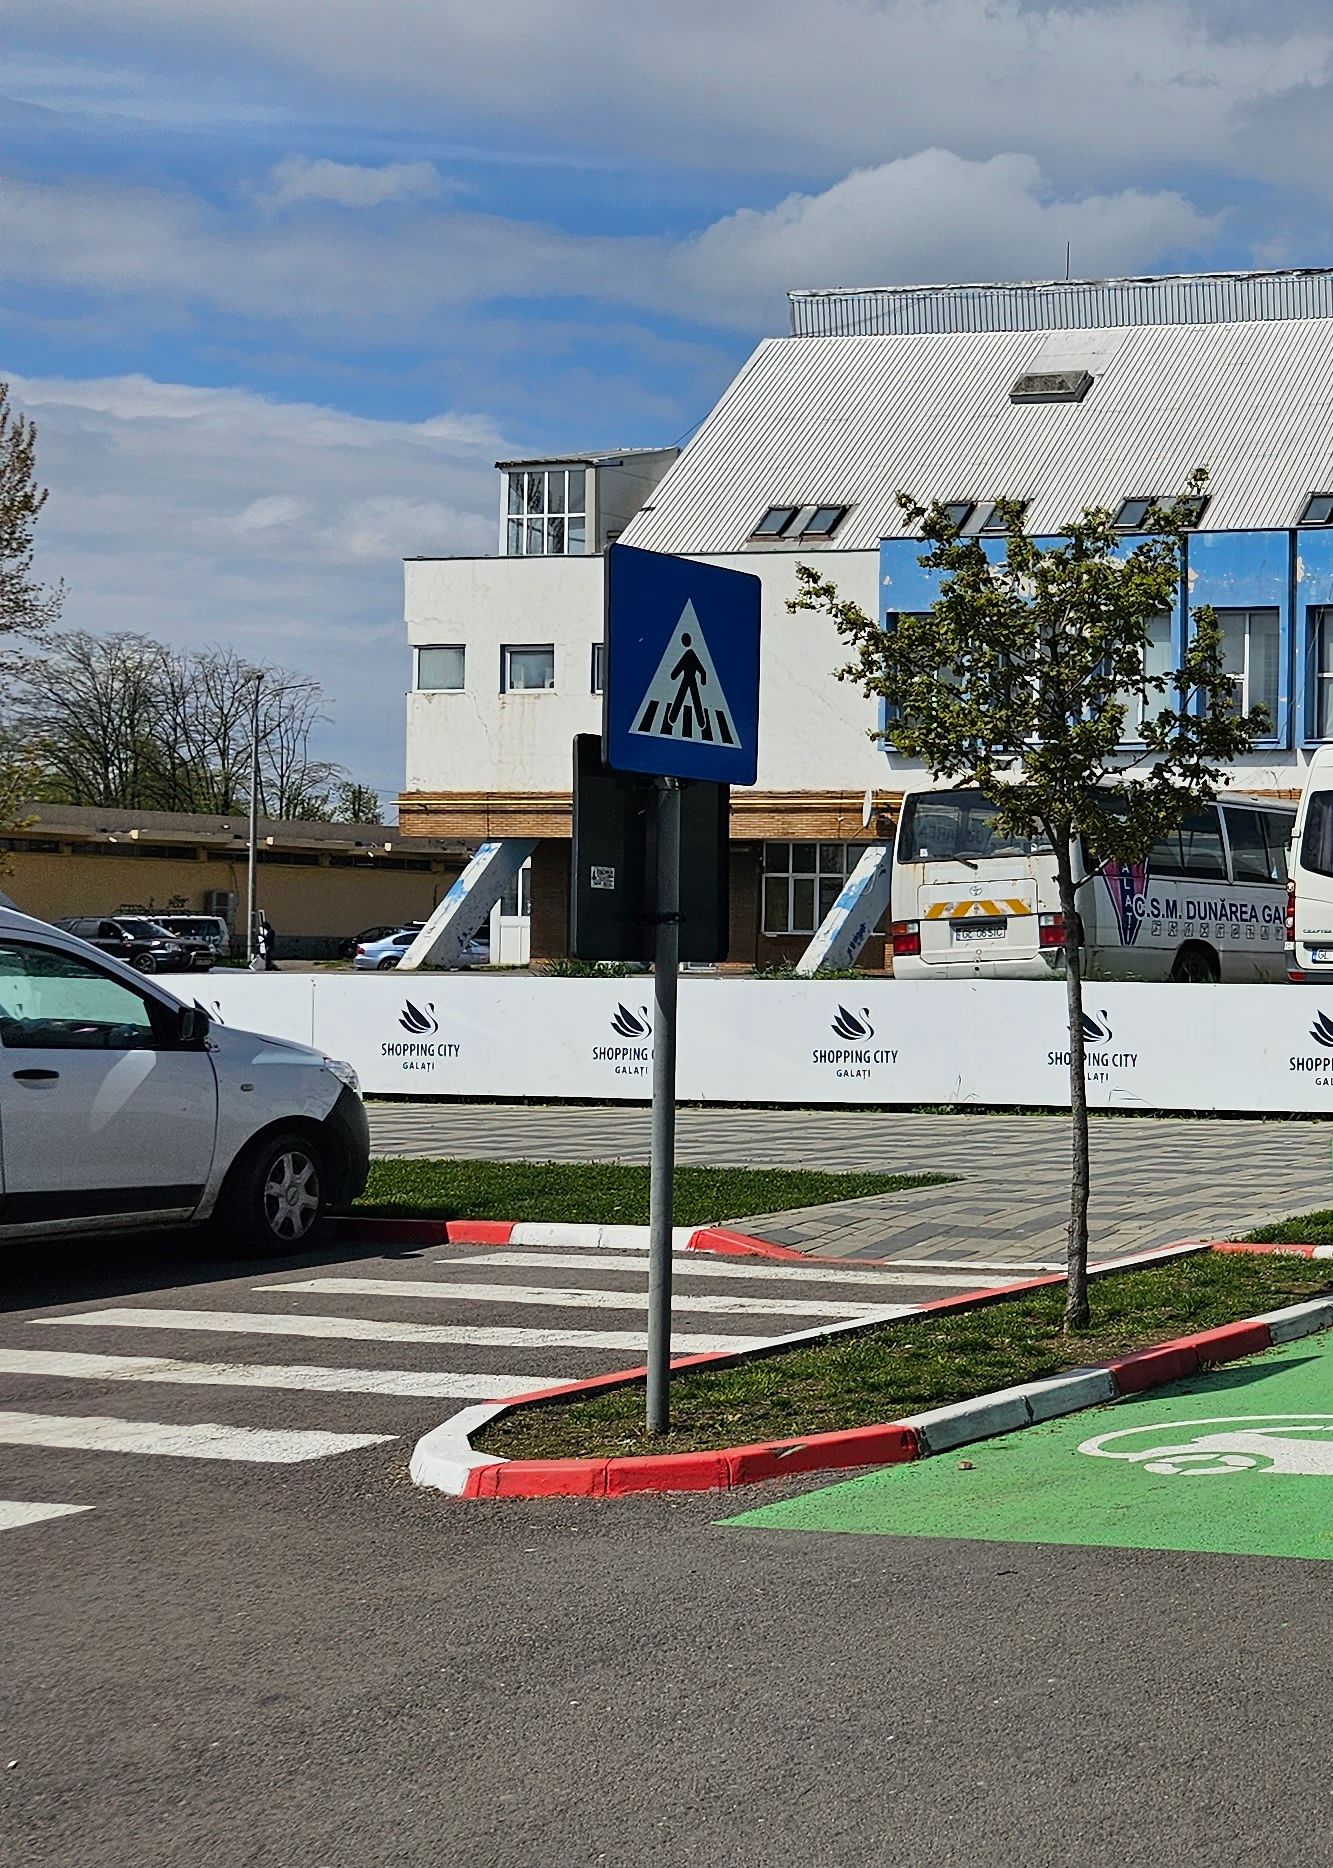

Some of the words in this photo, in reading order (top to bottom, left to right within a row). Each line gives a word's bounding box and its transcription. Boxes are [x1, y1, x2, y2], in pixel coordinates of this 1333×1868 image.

[1134, 895, 1182, 919] C.S.M.
[1186, 899, 1259, 922] DUNĂREA
[381, 1043, 435, 1056] SHOPPING
[437, 1043, 460, 1057] CITY
[592, 1047, 648, 1060] SHOPPING
[812, 1049, 871, 1063] SHOPPING
[873, 1050, 898, 1063] CITY
[1047, 1051, 1109, 1066] SHOING
[1112, 1053, 1137, 1067] CITY
[1087, 1072, 1109, 1083] LAȚI
